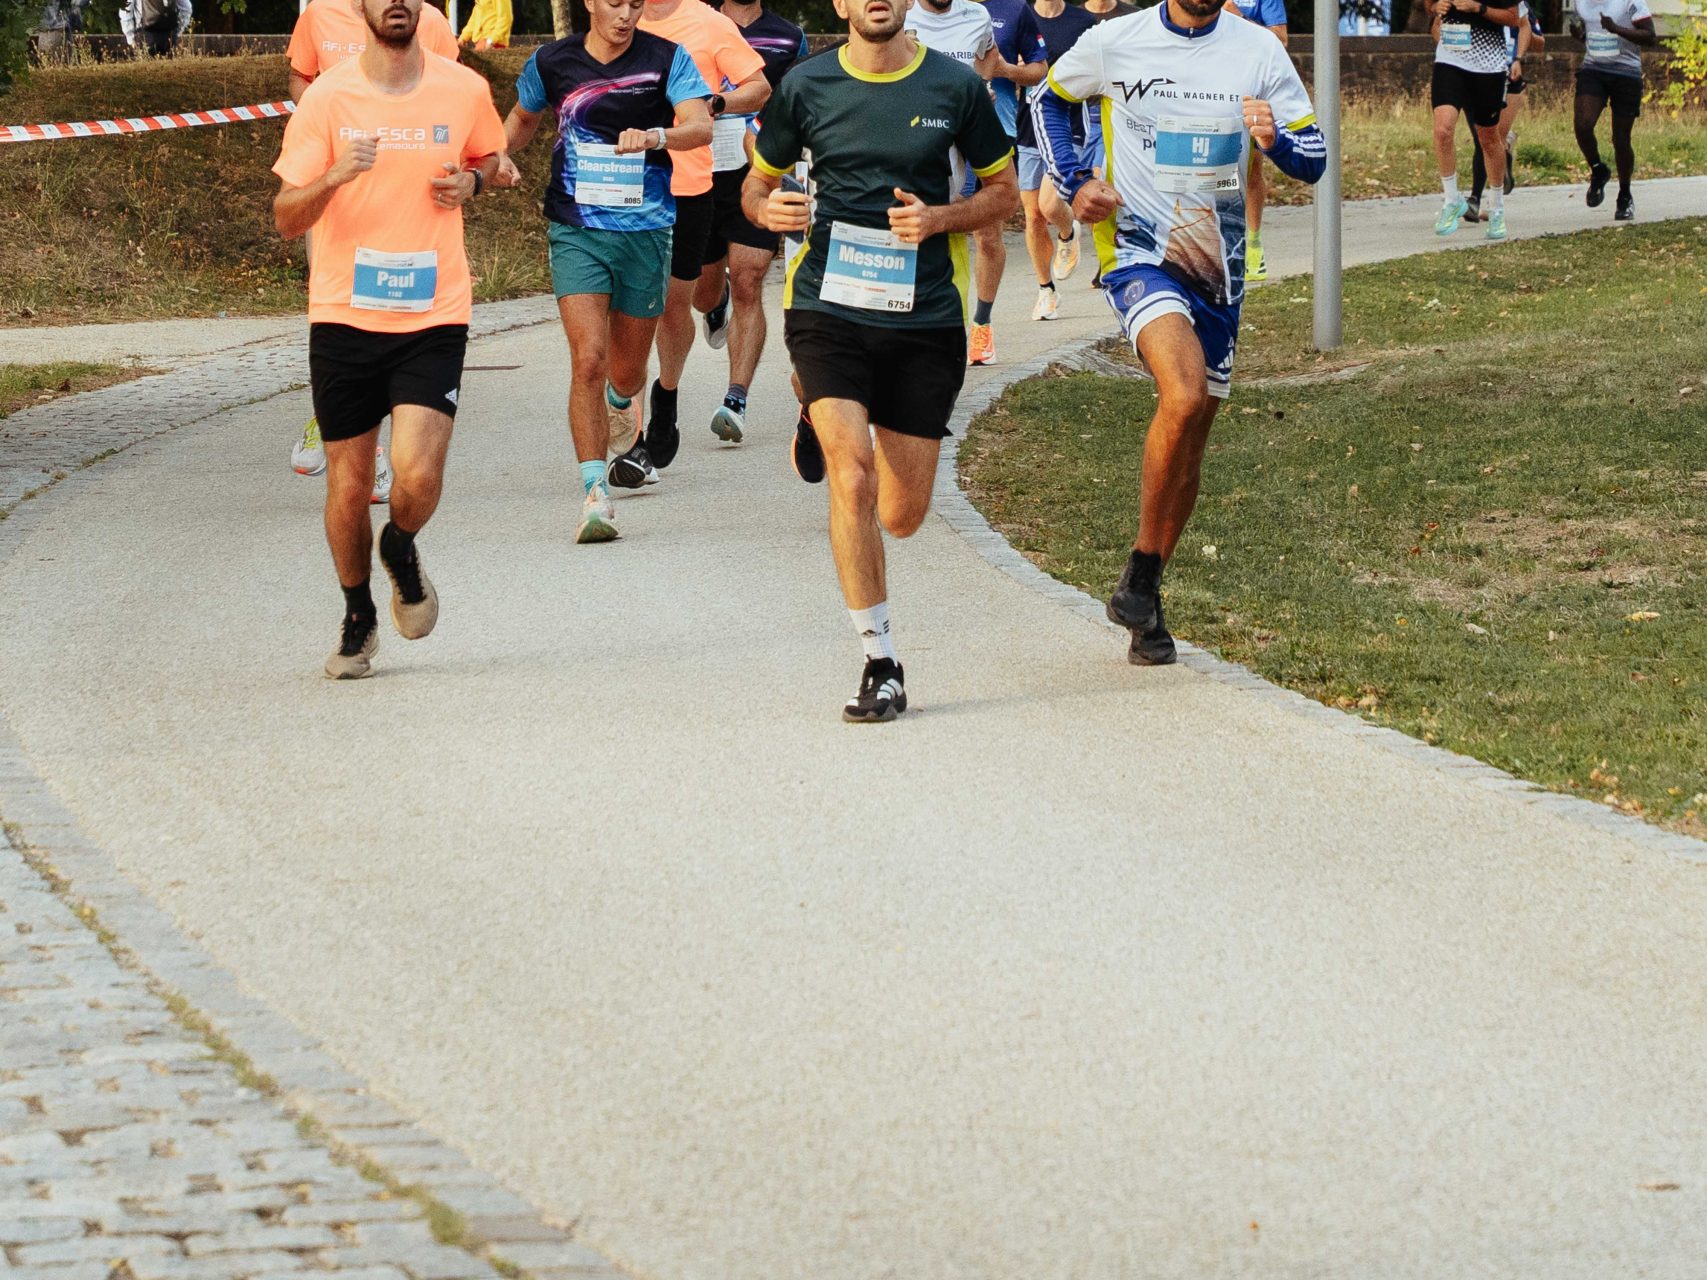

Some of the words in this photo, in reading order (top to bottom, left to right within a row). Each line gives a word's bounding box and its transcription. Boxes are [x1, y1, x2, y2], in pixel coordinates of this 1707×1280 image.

[1153, 89, 1178, 99] PAUL
[1184, 92, 1225, 101] WAGNER
[1229, 94, 1239, 102] ET
[921, 118, 949, 128] SMBC
[1191, 136, 1210, 157] Hj
[577, 159, 644, 174] Clearstream
[1216, 178, 1237, 189] 5968
[623, 197, 642, 205] 8085
[838, 244, 906, 271] Messon
[376, 270, 415, 288] Paul
[887, 299, 911, 311] 6754
